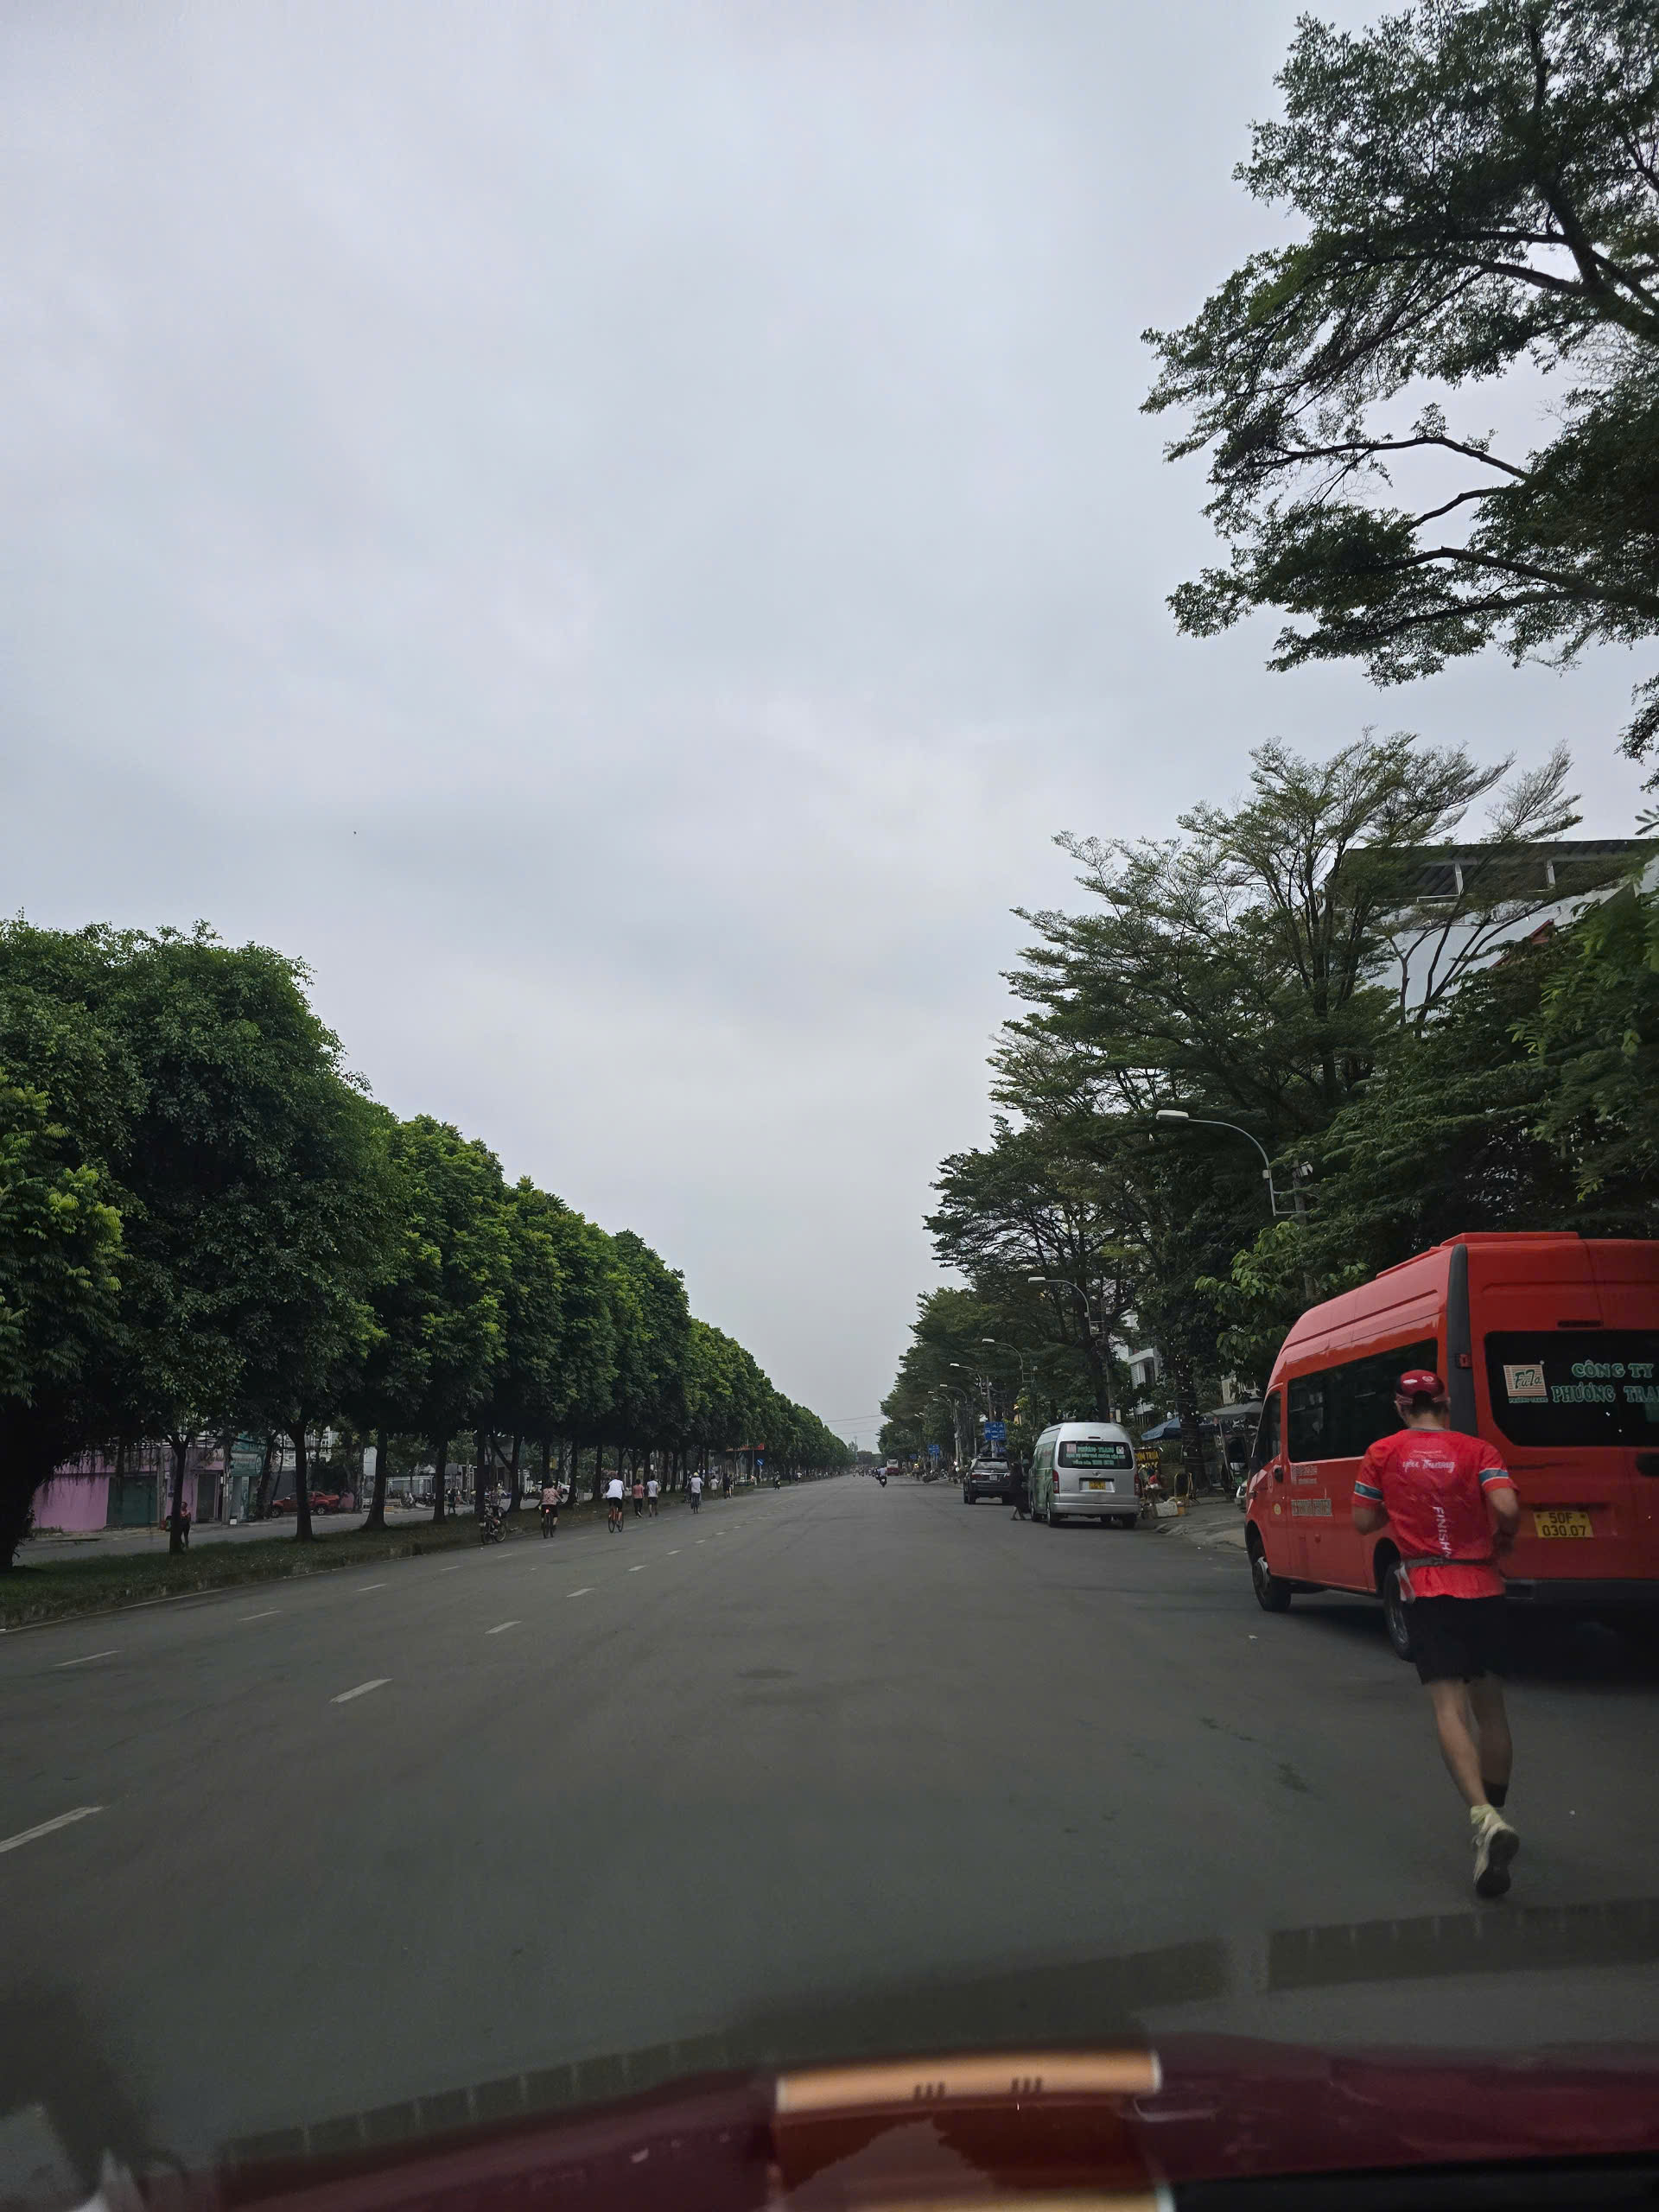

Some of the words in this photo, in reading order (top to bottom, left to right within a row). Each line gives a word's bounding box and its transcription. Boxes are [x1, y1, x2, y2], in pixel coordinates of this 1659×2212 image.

[1571, 1359, 1625, 1378] CÔNG
[1628, 1363, 1654, 1378] TY
[1551, 1381, 1616, 1403] PHƯƠNG
[1624, 1385, 1659, 1403] TRA
[1548, 1512, 1573, 1523] 50F
[1541, 1525, 1586, 1536] 030.07
